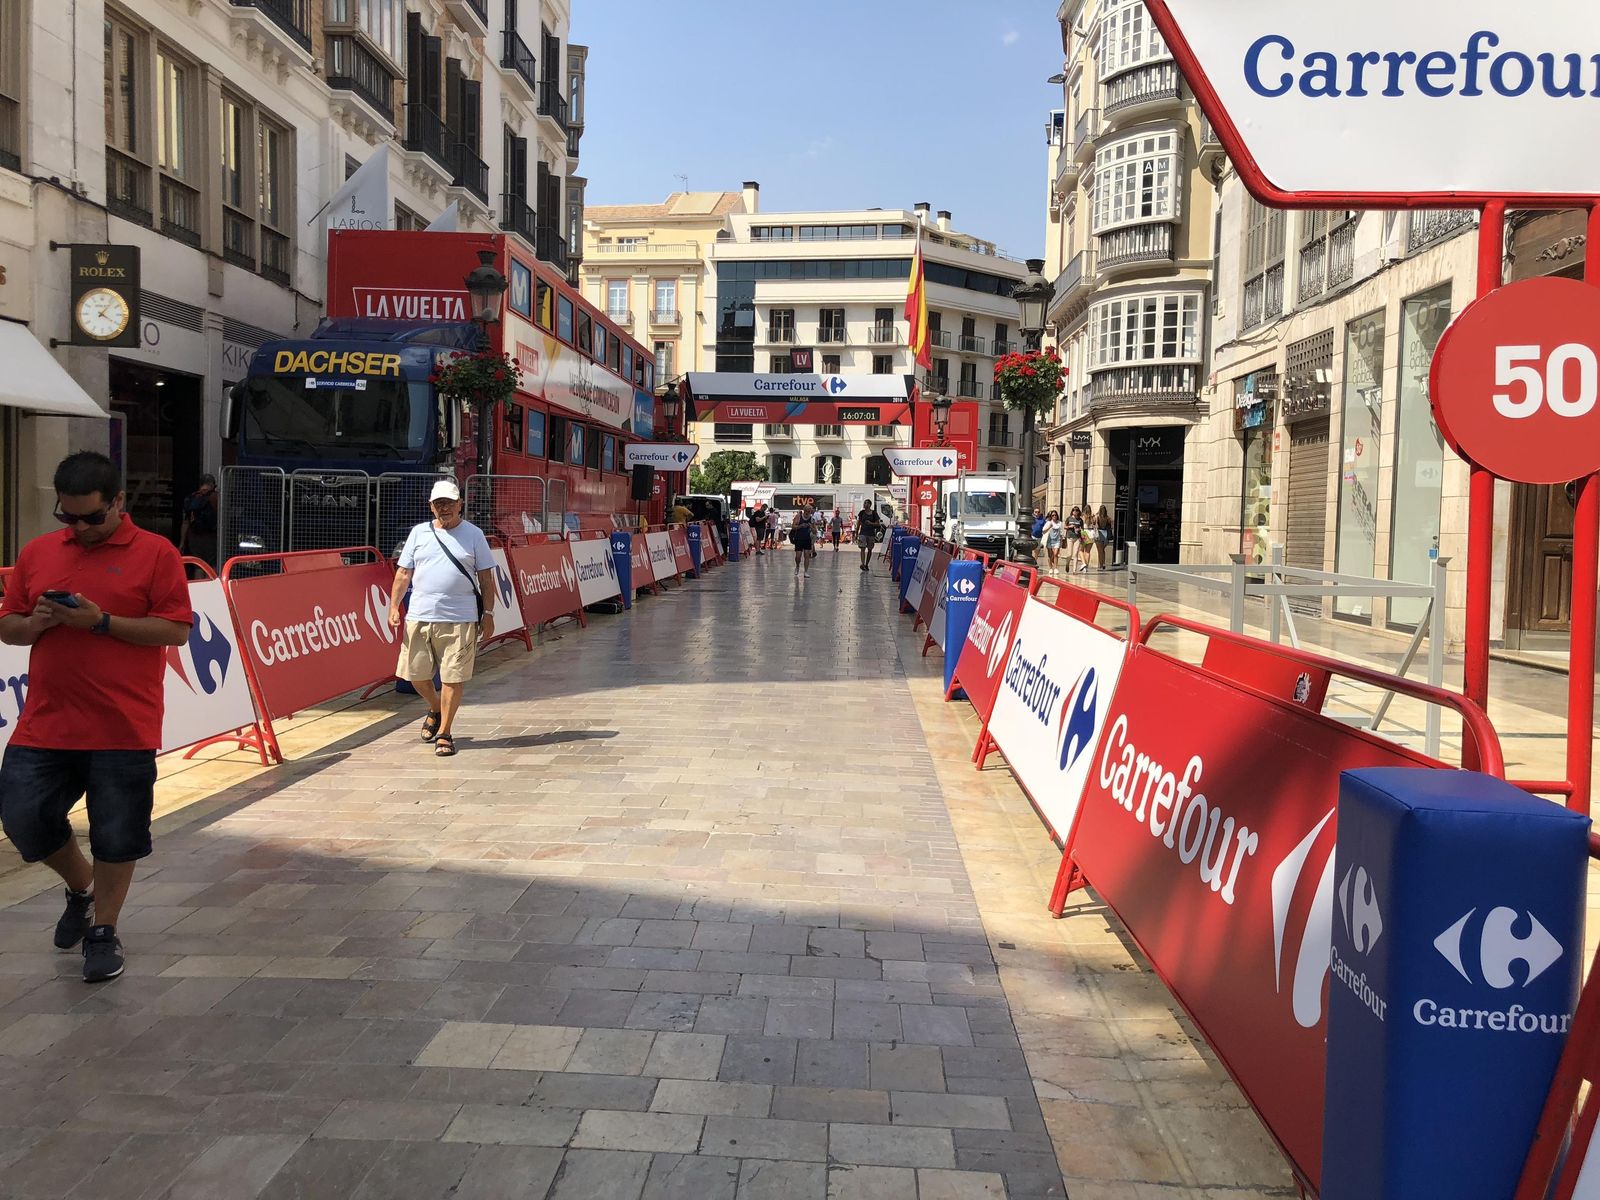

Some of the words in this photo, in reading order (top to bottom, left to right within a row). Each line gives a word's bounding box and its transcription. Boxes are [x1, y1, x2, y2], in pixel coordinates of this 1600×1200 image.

[332, 216, 382, 231] LARIOS
[80, 266, 126, 278] ROLEX
[366, 294, 389, 317] LA
[392, 295, 466, 320] VUELTA
[222, 342, 250, 369] KIK
[274, 350, 401, 377] DACHSER
[796, 353, 808, 366] LV
[754, 378, 816, 391] Carrefour
[1492, 343, 1598, 419] 50
[730, 407, 739, 417] LA
[739, 408, 764, 417] VUELTA
[842, 411, 876, 421] 16:07:01
[629, 451, 669, 463] Carrefour
[893, 457, 934, 467] Carrefour
[304, 494, 358, 508] MAN
[792, 496, 815, 506] rtve
[920, 491, 932, 500] 25
[520, 564, 560, 597] Carrefour
[576, 557, 604, 587] Carrefour
[250, 605, 362, 667] Carrefour
[967, 603, 994, 656] Carrefour
[1004, 637, 1061, 727] Carrefour
[1100, 713, 1259, 906] Carrefour
[1329, 944, 1388, 1023] Carrefour
[1411, 997, 1572, 1034] Carrefour
